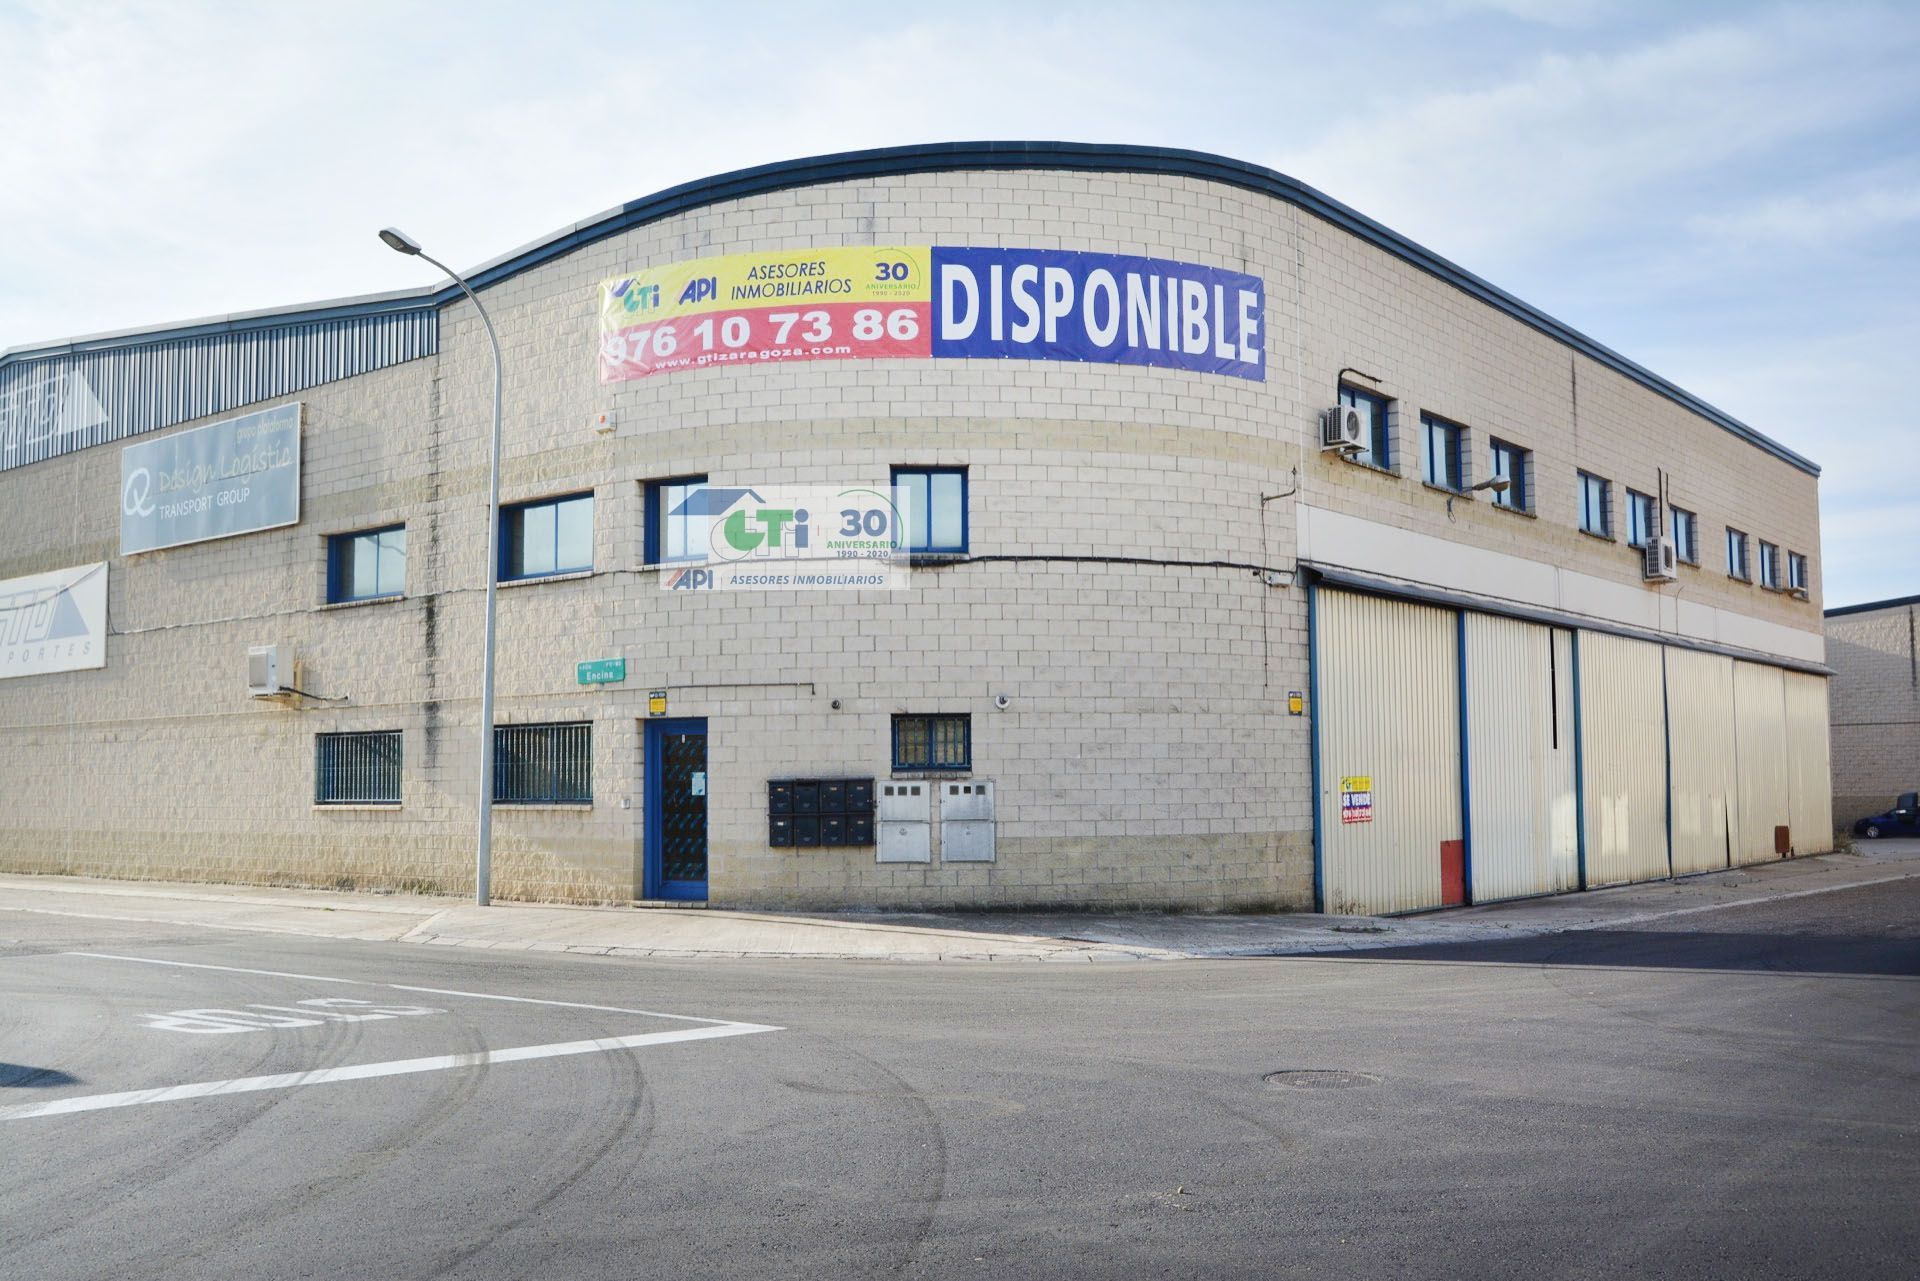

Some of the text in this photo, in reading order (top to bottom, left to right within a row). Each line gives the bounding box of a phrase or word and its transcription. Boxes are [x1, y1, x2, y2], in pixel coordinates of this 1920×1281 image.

[747, 262, 826, 282] ASESORES
[875, 262, 909, 281] 30
[678, 276, 717, 306] API
[731, 278, 852, 301] INMOBILIARIOS
[866, 283, 917, 291] ANIVERSARIO
[941, 264, 1260, 365] DISPONIBLE
[606, 309, 919, 366] 976 10 73 86
[655, 344, 851, 370] www.gtizaragoza.com
[160, 460, 216, 494] Design
[159, 487, 250, 520] TRANSPORT GROUP
